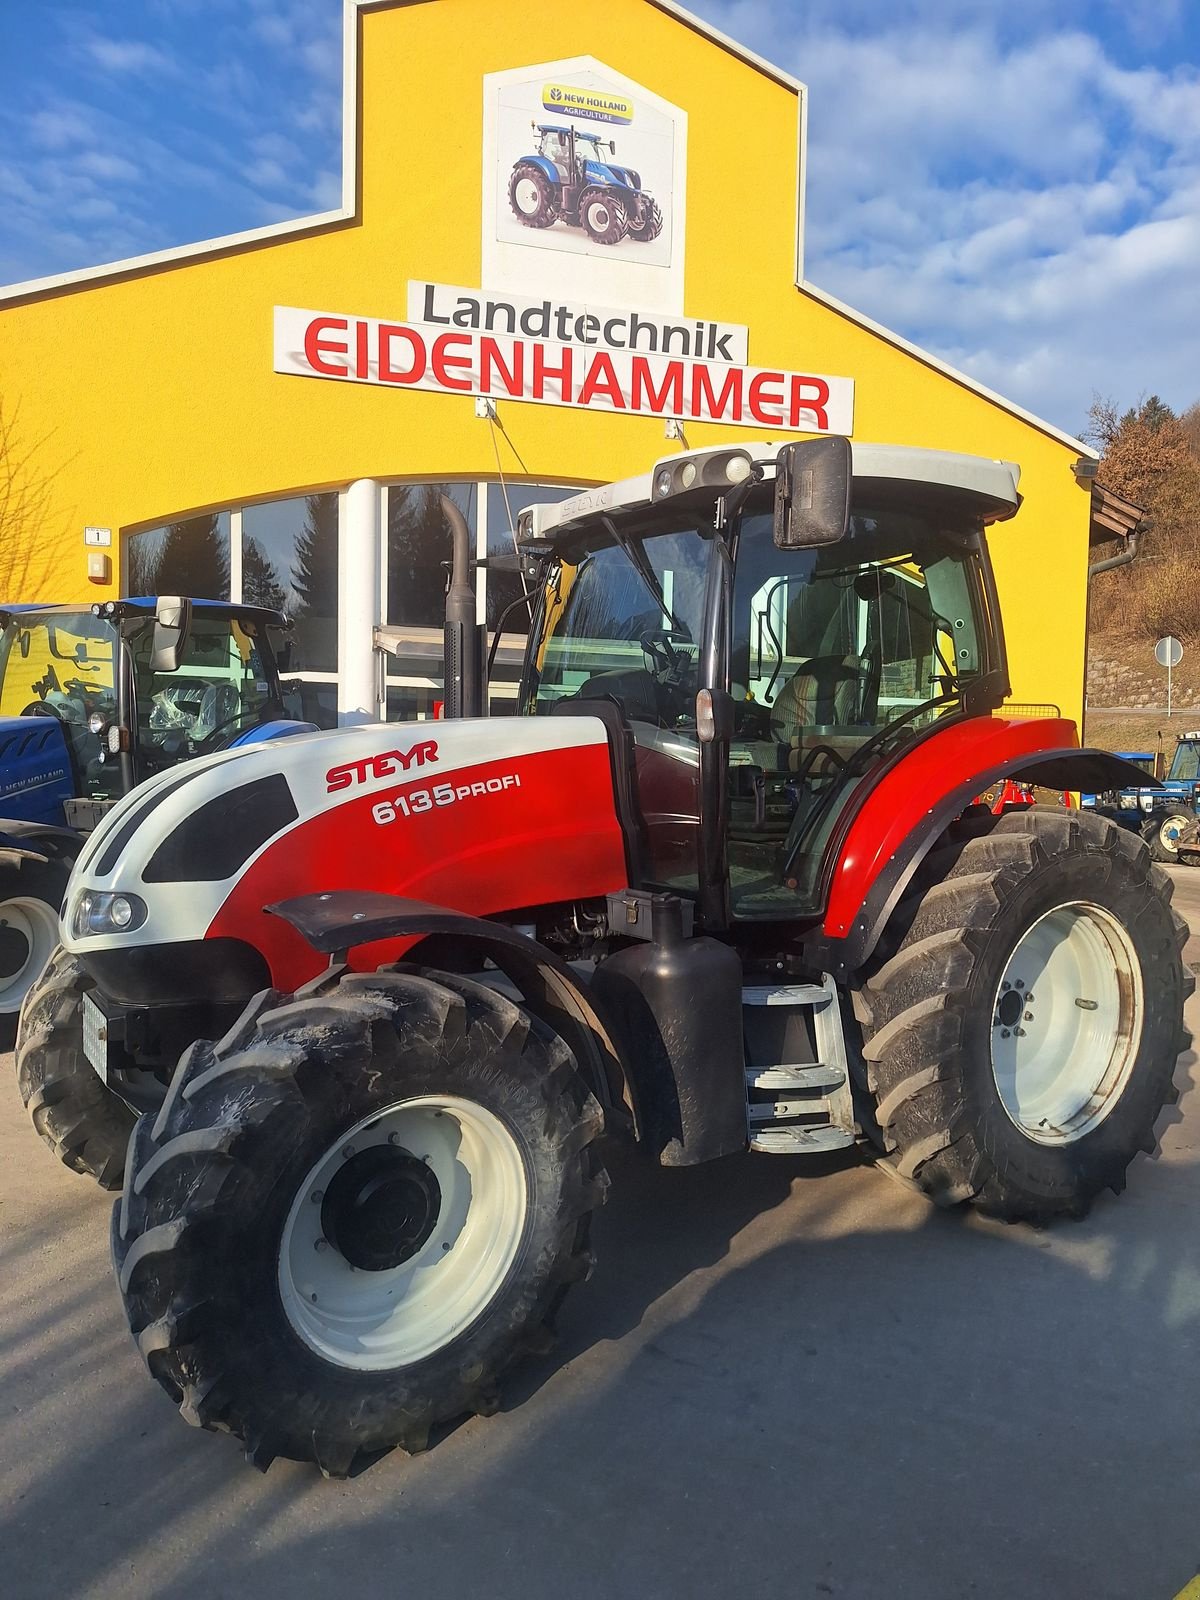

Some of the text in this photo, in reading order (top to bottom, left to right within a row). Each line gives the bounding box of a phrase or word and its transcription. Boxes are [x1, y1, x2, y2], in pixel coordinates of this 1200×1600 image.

[563, 107, 613, 121] AGRICULTURE
[564, 93, 627, 112] NEW HOLLAND
[423, 284, 734, 361] Landtechnik
[304, 317, 829, 429] EIDENHAMMER
[95, 531, 100, 542] 1
[5, 769, 64, 791] NEW HOLLAND
[325, 739, 440, 794] STEYR
[371, 773, 522, 826] 6135 PROFI
